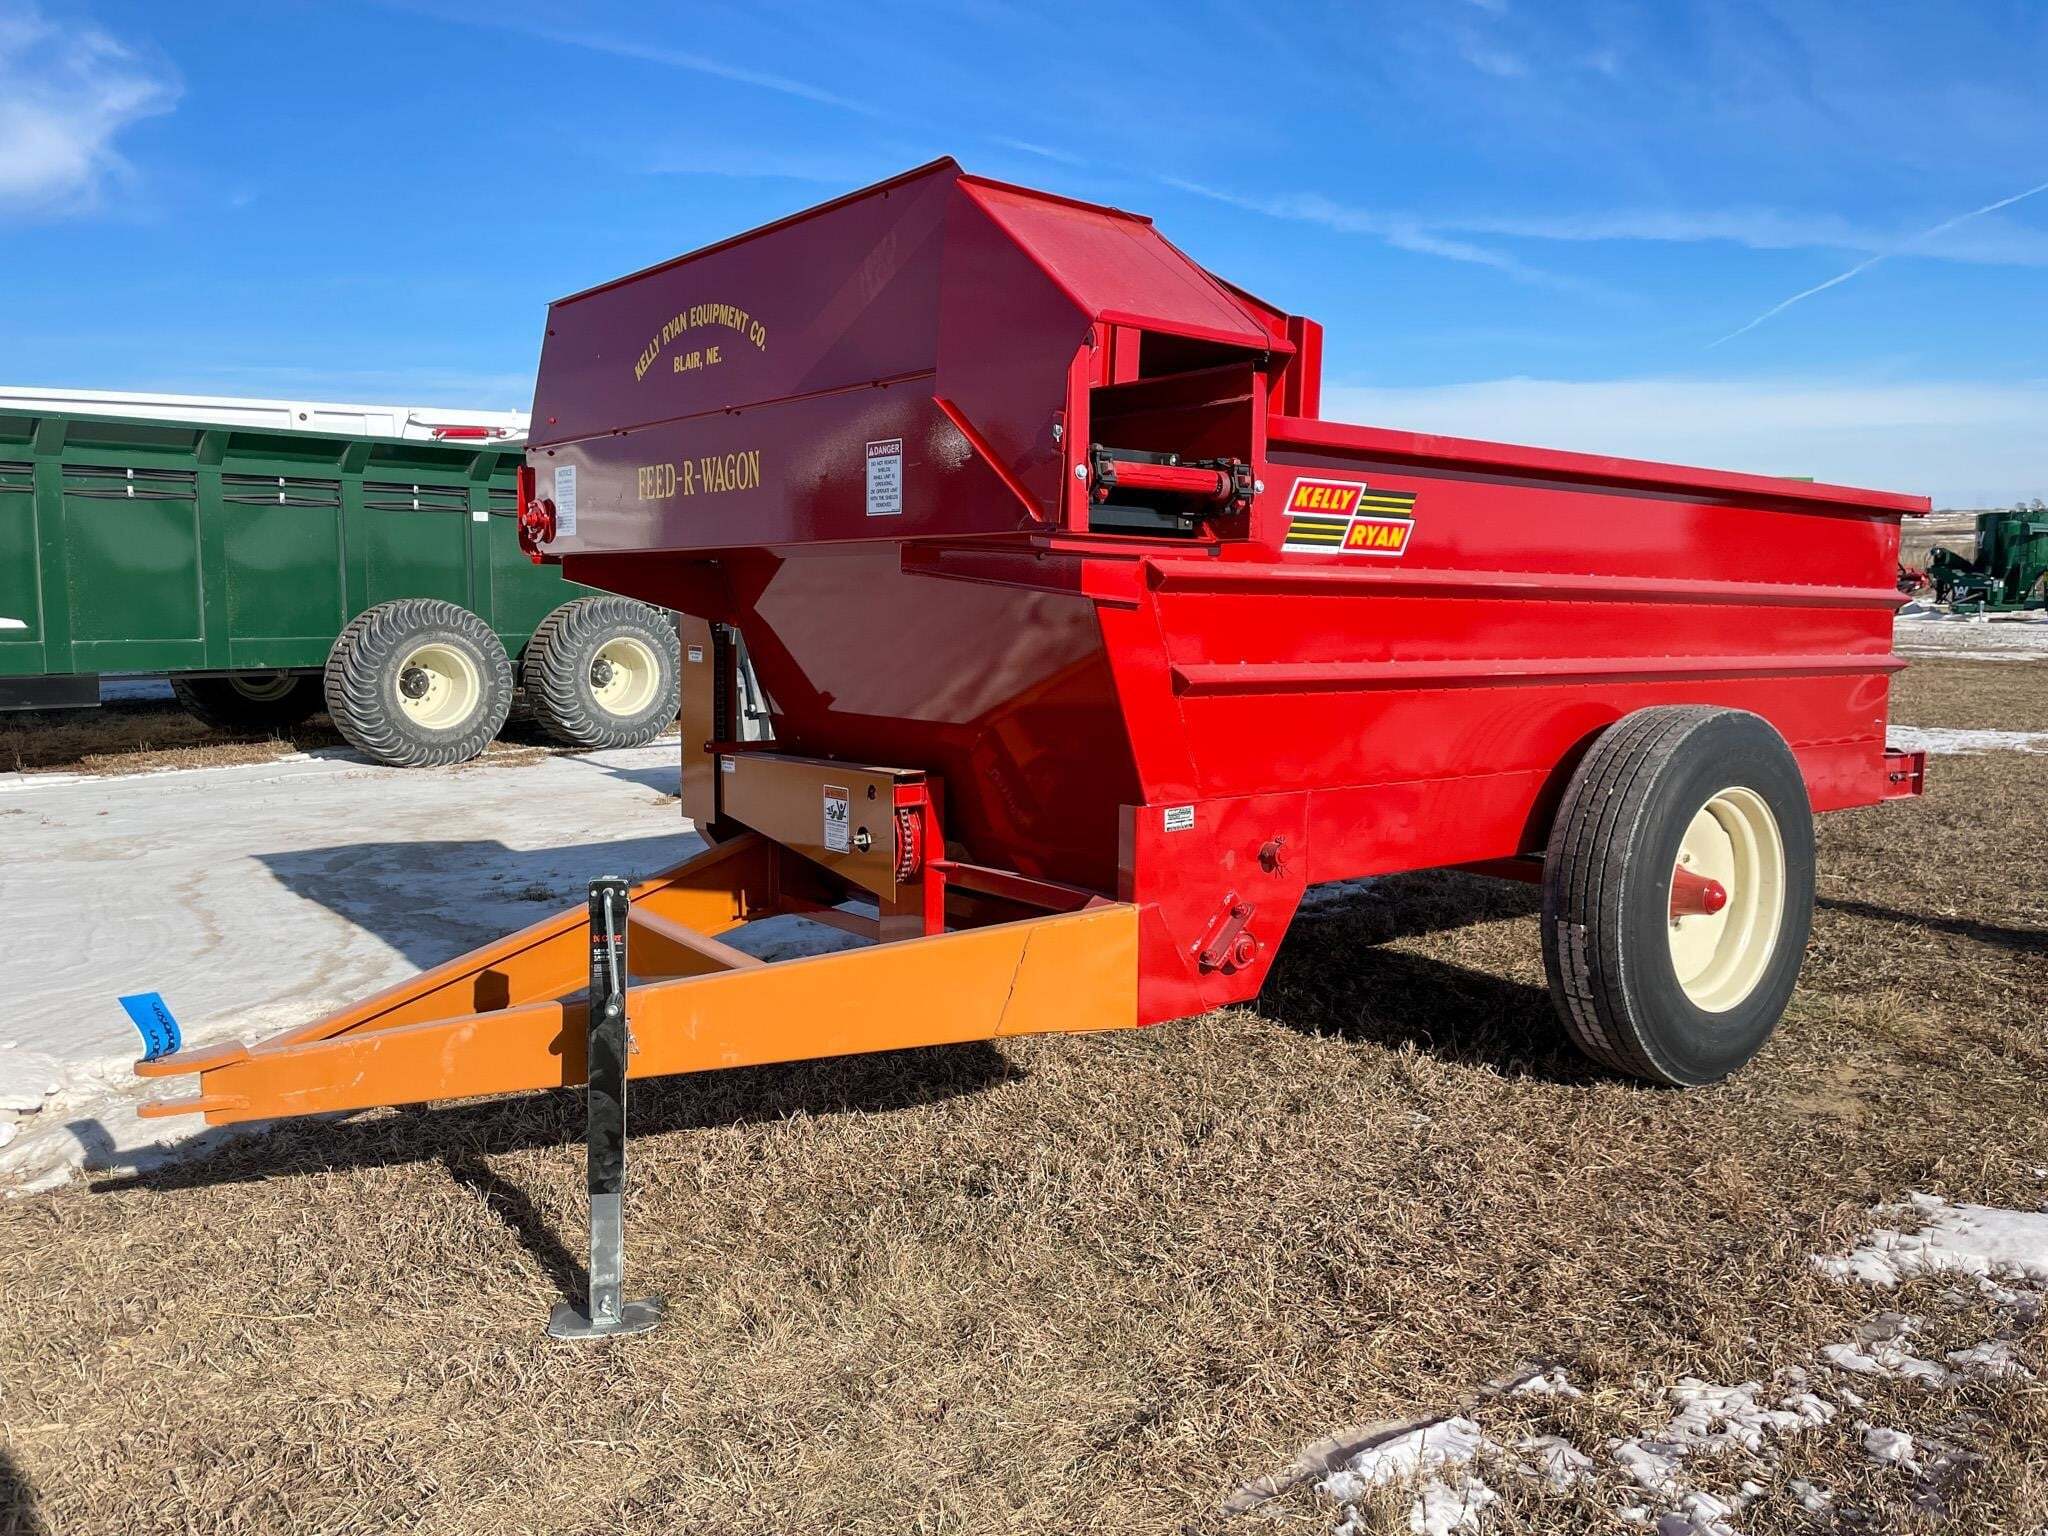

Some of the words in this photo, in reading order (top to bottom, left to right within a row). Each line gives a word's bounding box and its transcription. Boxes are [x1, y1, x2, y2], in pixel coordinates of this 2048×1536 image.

[634, 334, 660, 382] KELLY
[662, 312, 688, 345] RYAN
[690, 303, 749, 333] EQUIPMENT
[749, 320, 767, 352] CO.
[673, 351, 703, 373] BLAIR,
[706, 346, 722, 365] NE.
[873, 443, 900, 456] DANGER
[638, 450, 760, 500] FEED-R-WAGON
[1294, 486, 1356, 510] KELLY
[1349, 524, 1406, 548] RYAN
